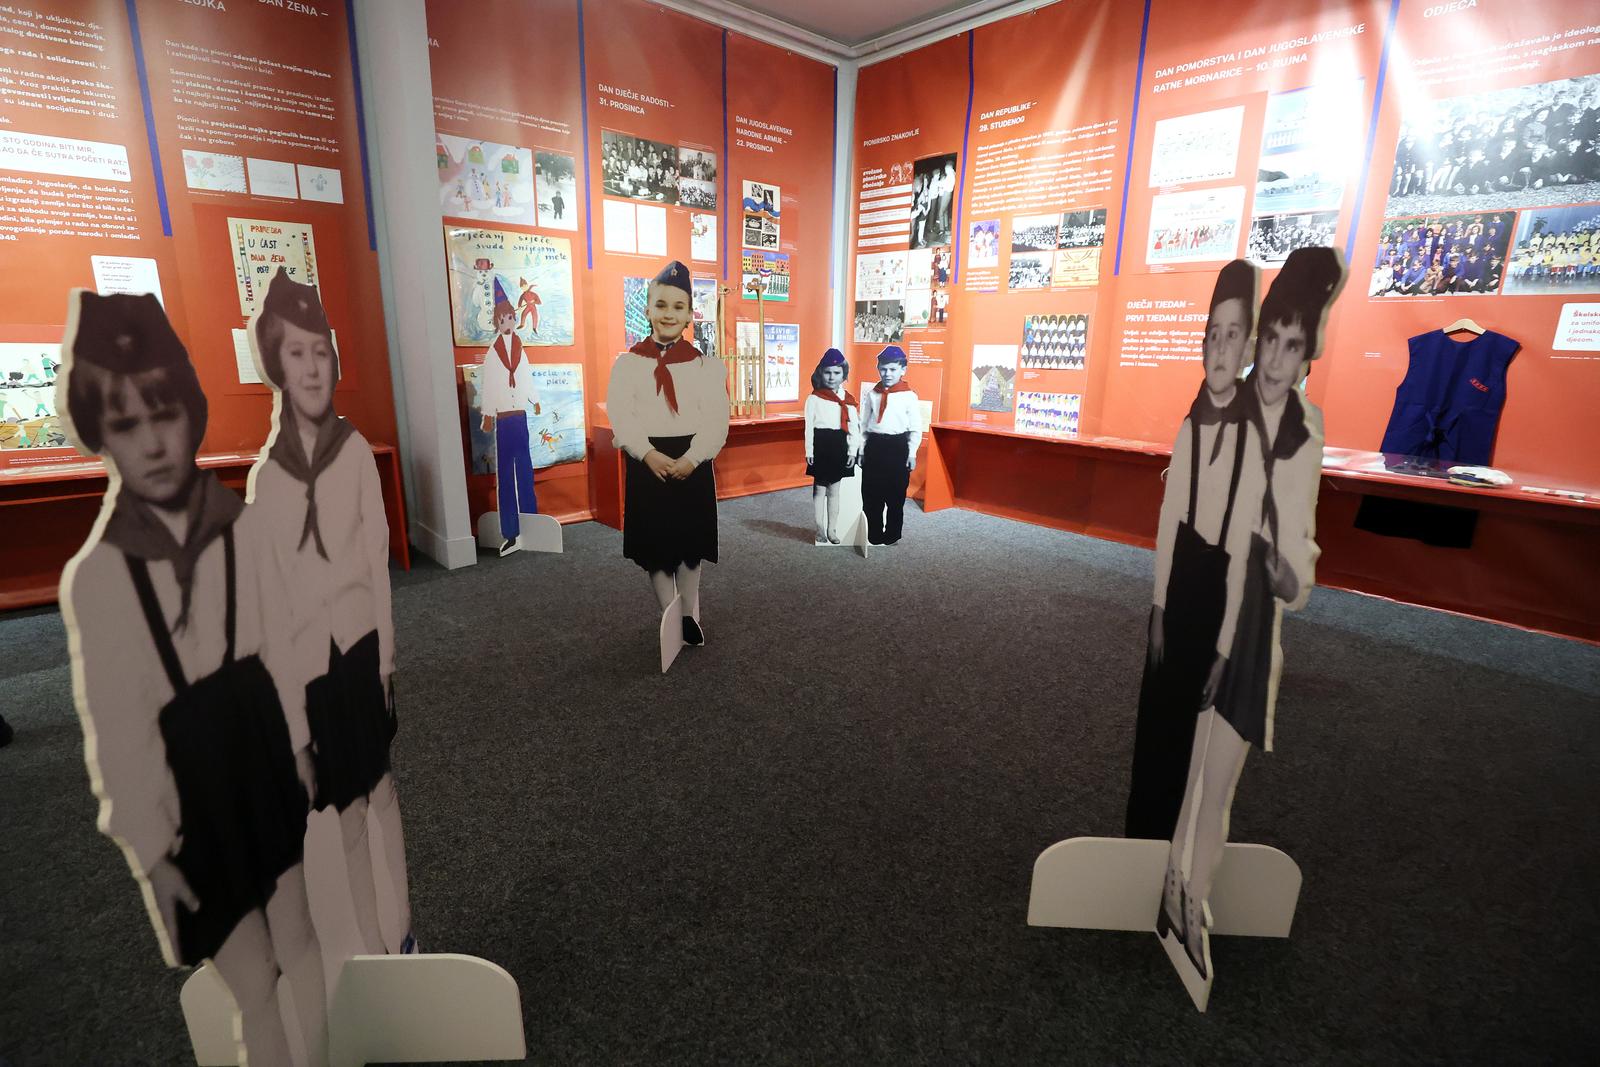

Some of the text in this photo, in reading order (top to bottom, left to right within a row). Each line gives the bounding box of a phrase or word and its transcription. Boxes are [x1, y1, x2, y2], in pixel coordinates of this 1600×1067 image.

[1552, 32, 1561, 42] je
[18, 50, 38, 58] rada
[1155, 67, 1174, 79] DAN
[1176, 54, 1235, 74] POMORSTVA
[1244, 45, 1266, 58] DAN
[1268, 23, 1365, 54] JUGOSLAVENSKE
[1531, 40, 1585, 57] naglaskom
[1153, 79, 1182, 94] RATNE
[1184, 67, 1243, 86] MORNARICE
[1255, 62, 1269, 73] 10.
[1272, 53, 1308, 68] RUJNA
[20, 79, 38, 88] Kroz
[598, 83, 614, 95] DAN
[615, 86, 640, 101] DJEČJE
[640, 94, 669, 108] RADOSTI
[46, 104, 90, 115] socijalizma
[599, 97, 645, 115] 31. PROSINCA
[980, 102, 1031, 121] DAN REPUBLIKE
[736, 115, 793, 136] DAN JUGOSLAVENSKE
[979, 123, 990, 132] 29.
[269, 129, 298, 138] poginulih
[736, 127, 762, 140] NARODNE
[3, 136, 21, 145] STO
[23, 139, 56, 149] GODINA
[59, 143, 75, 151] BITI
[736, 139, 773, 154] 22. PROSINCA
[863, 135, 891, 147] PIONIRSKO
[45, 151, 73, 160] SUTRA
[76, 153, 105, 164] POČETI
[112, 168, 127, 176] Tito
[82, 183, 92, 191] da
[94, 184, 116, 193] budeš
[41, 188, 64, 197] budeš
[67, 191, 92, 201] primjer
[95, 195, 129, 203] upornosti
[41, 198, 65, 208] zemlje
[66, 200, 80, 208] kao
[82, 201, 93, 209] što
[102, 203, 115, 211] bila
[18, 206, 48, 214] slobodu
[51, 209, 70, 218] svoje
[72, 210, 98, 220] zemlje,
[20, 215, 34, 223] bila
[36, 217, 63, 226] primjer
[72, 219, 88, 227] radu
[102, 221, 125, 230] obnovi
[48, 228, 74, 236] poruke
[110, 232, 140, 240] omladini
[248, 238, 255, 248] U
[1127, 299, 1186, 309] DJEČJI TJEDAN
[1125, 314, 1143, 322] PRVI
[1146, 314, 1177, 322] TJEDAN
